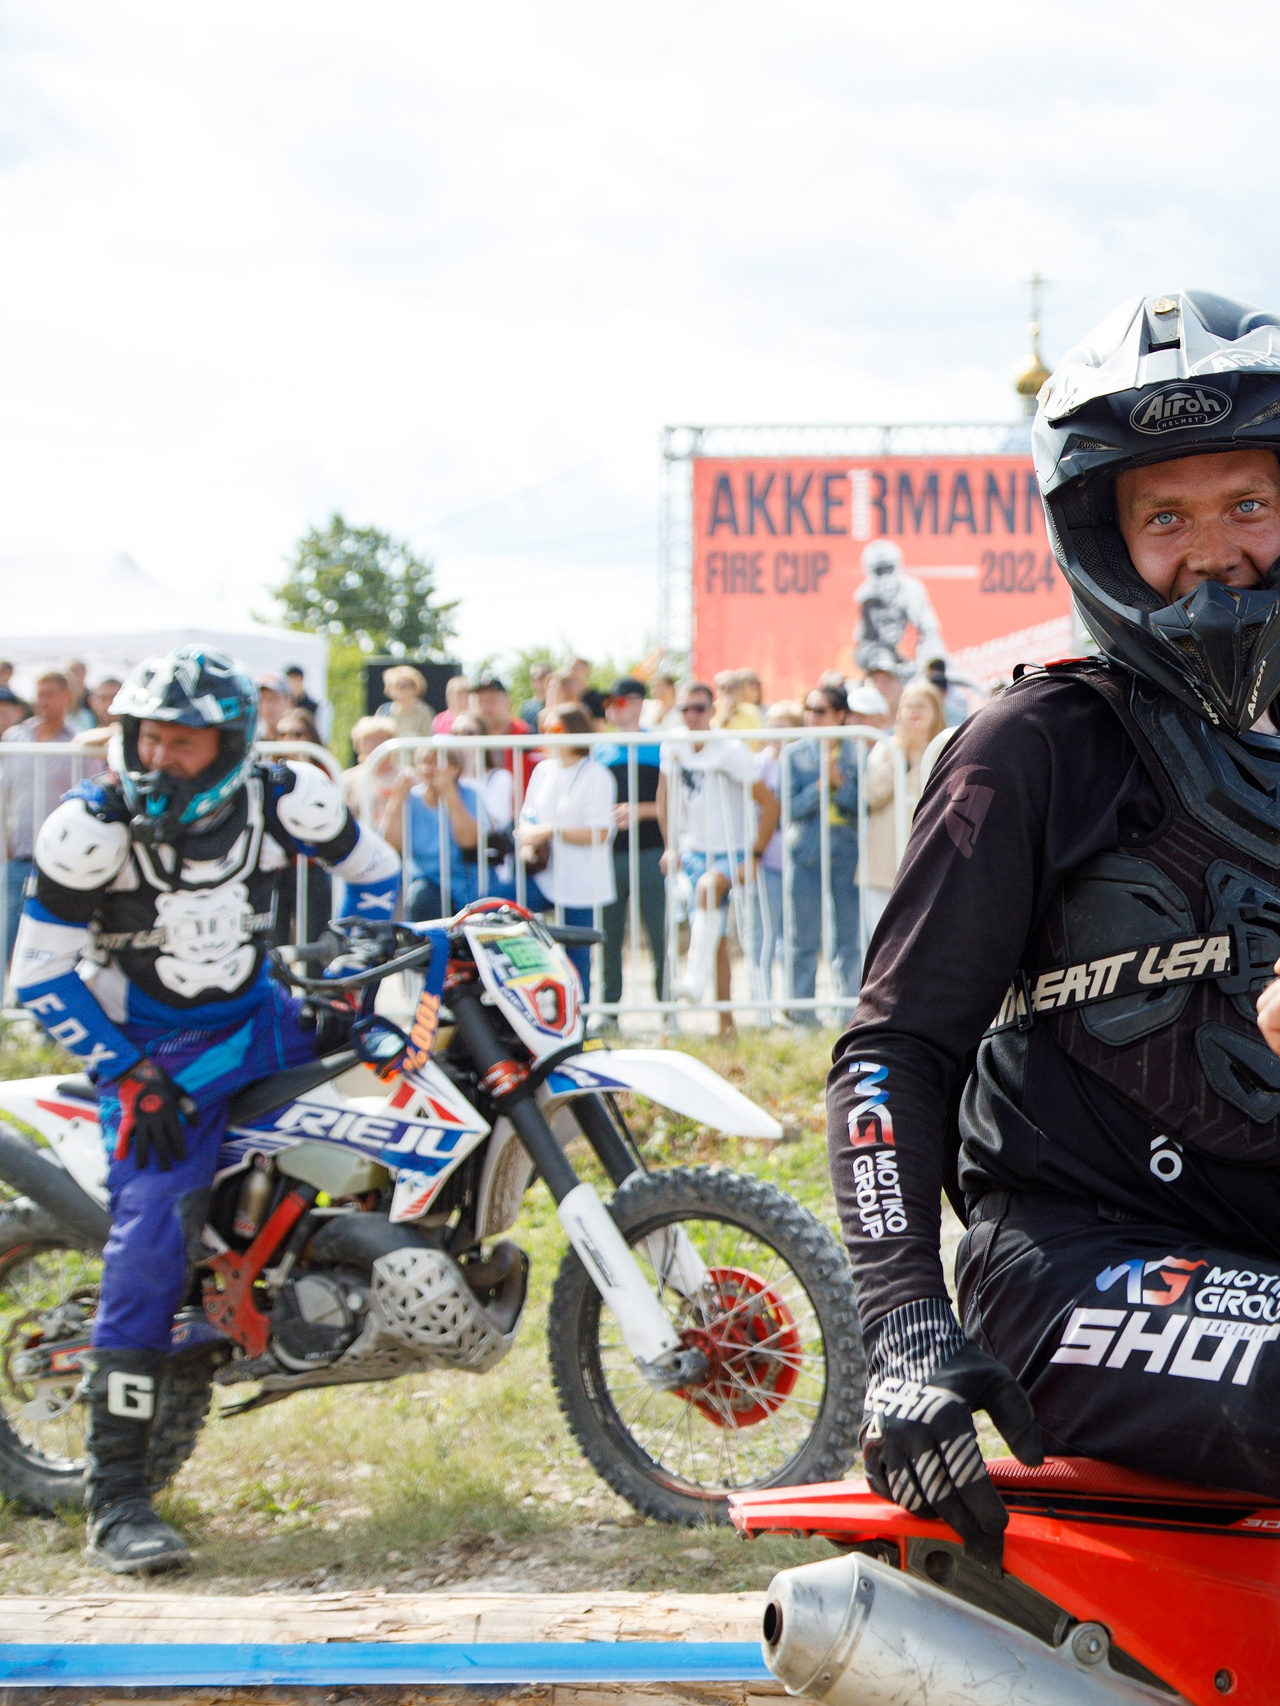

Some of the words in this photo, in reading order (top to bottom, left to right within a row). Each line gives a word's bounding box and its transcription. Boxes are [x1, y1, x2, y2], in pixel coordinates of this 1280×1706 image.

[1140, 390, 1221, 425] Airoh
[1162, 416, 1202, 428] HELMET
[706, 551, 765, 594] FIRE
[774, 551, 829, 594] CUP
[980, 550, 1056, 593] 2024
[1138, 935, 1231, 985] LEA
[23, 992, 118, 1070] FOX
[403, 991, 440, 1072] 100%
[274, 1104, 467, 1159] RIEJU
[853, 1154, 885, 1240] GROUP
[875, 1150, 908, 1234] MOTIKO
